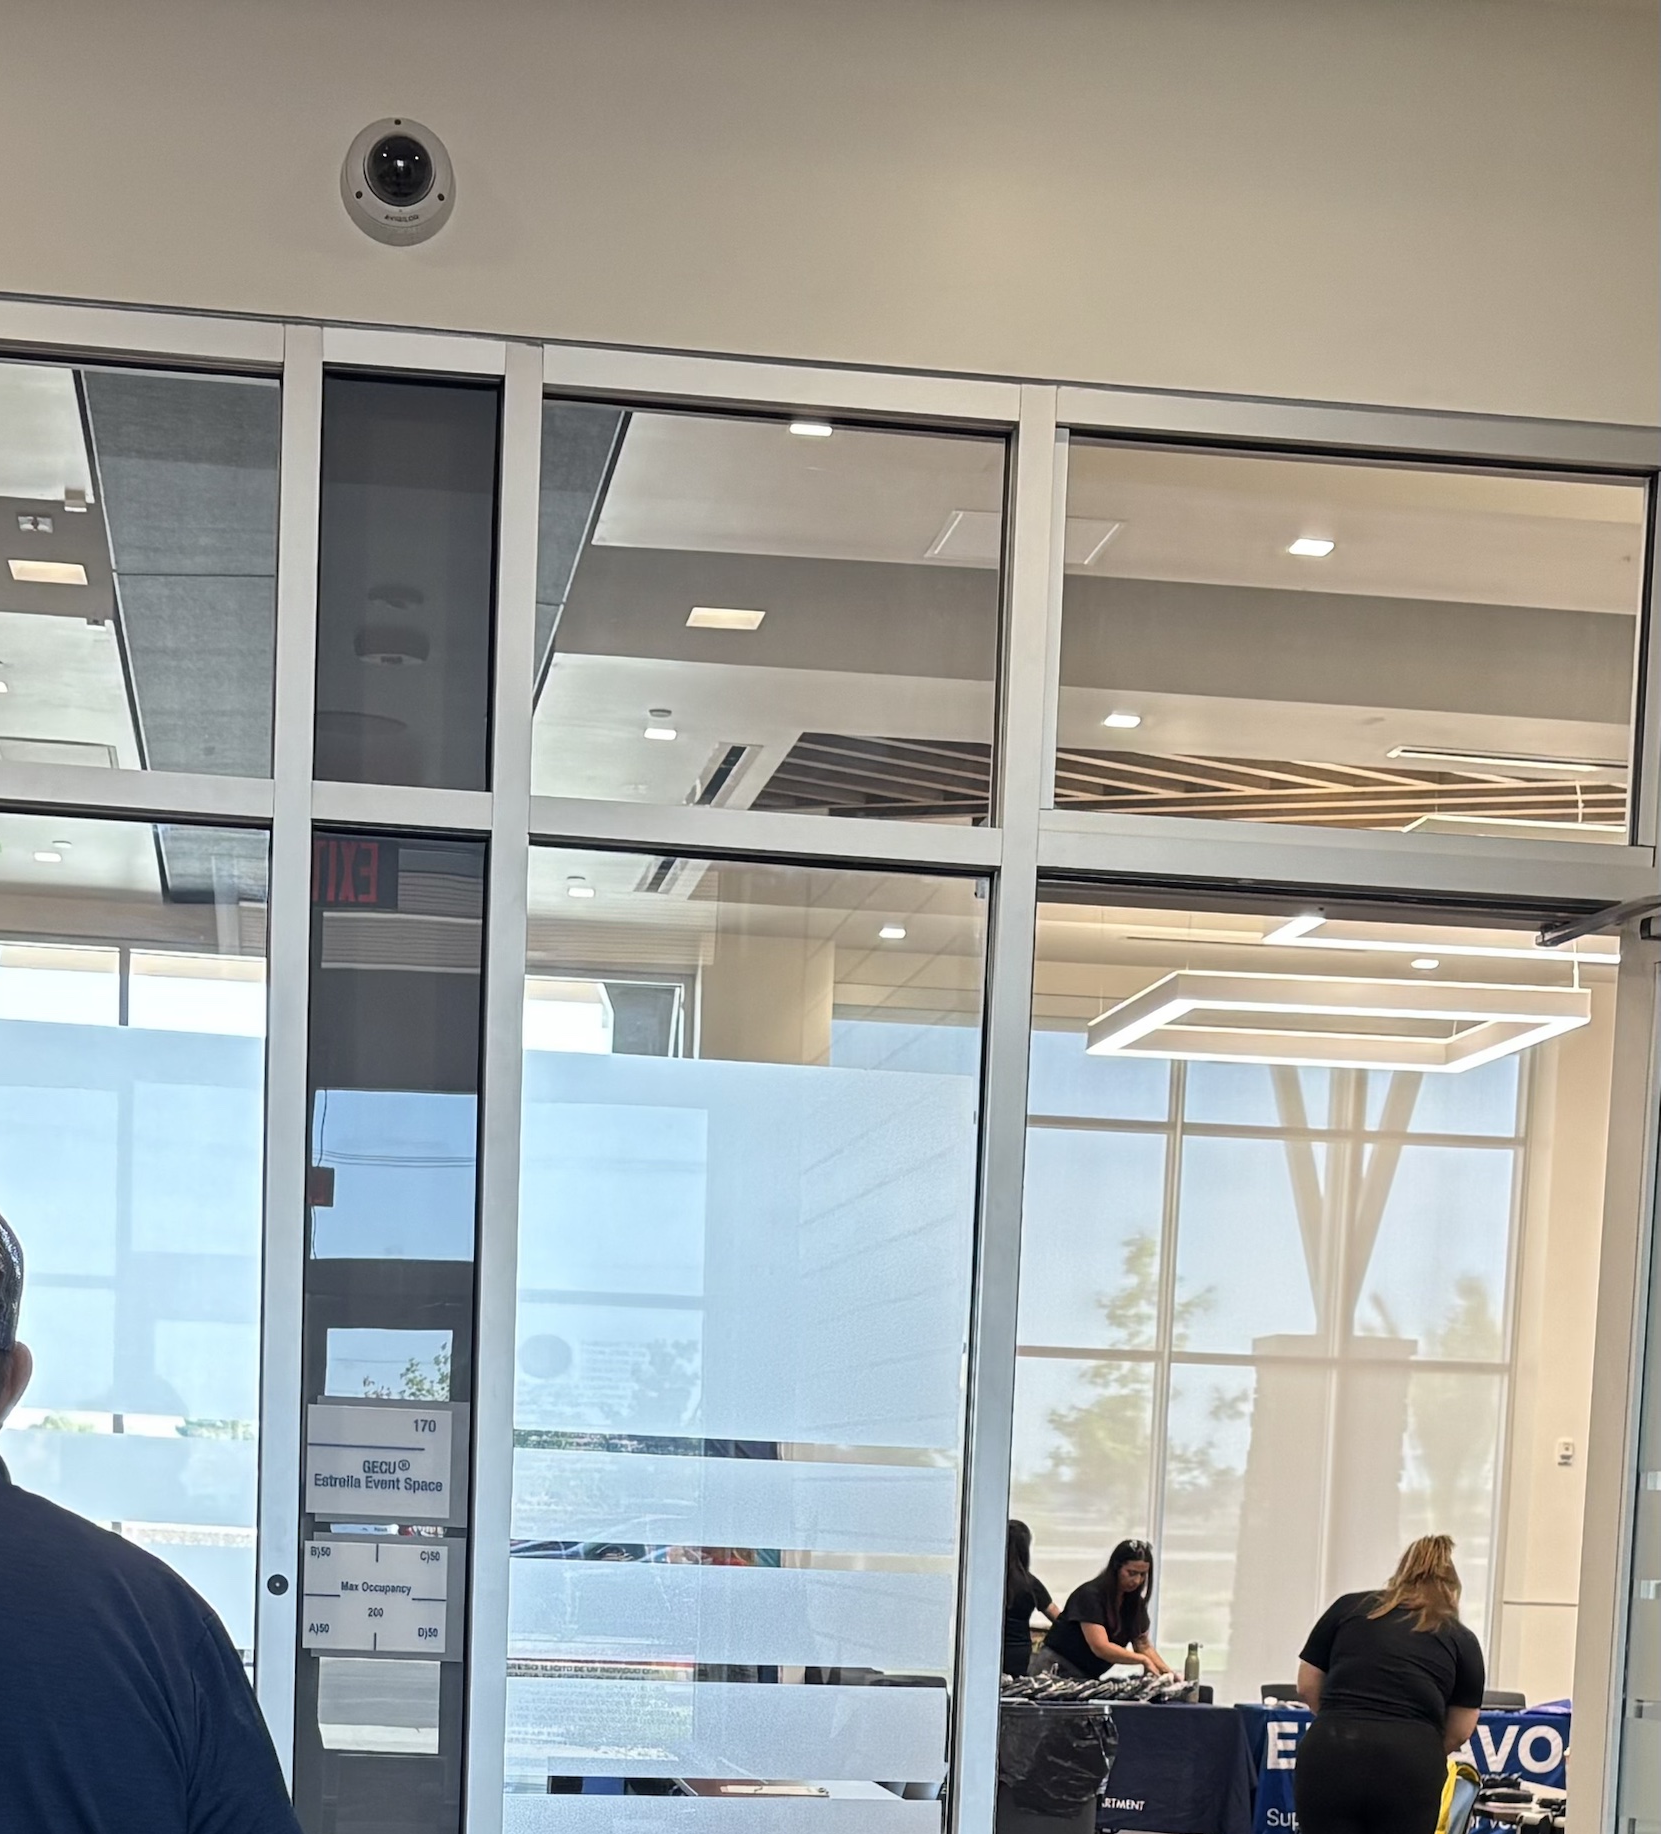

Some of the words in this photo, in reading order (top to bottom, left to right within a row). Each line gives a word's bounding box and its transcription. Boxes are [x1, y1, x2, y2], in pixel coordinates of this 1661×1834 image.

[413, 1419, 436, 1433] 170
[314, 1473, 361, 1489] Estrella
[365, 1476, 401, 1490] Event
[404, 1477, 443, 1494] Space
[419, 1550, 441, 1563] C)50
[341, 1581, 359, 1591] Max
[361, 1582, 412, 1596] Occupancy
[367, 1607, 384, 1617] 200
[309, 1623, 330, 1636] A)50
[417, 1627, 439, 1640] D)50
[1102, 1797, 1146, 1811] RTMENT
